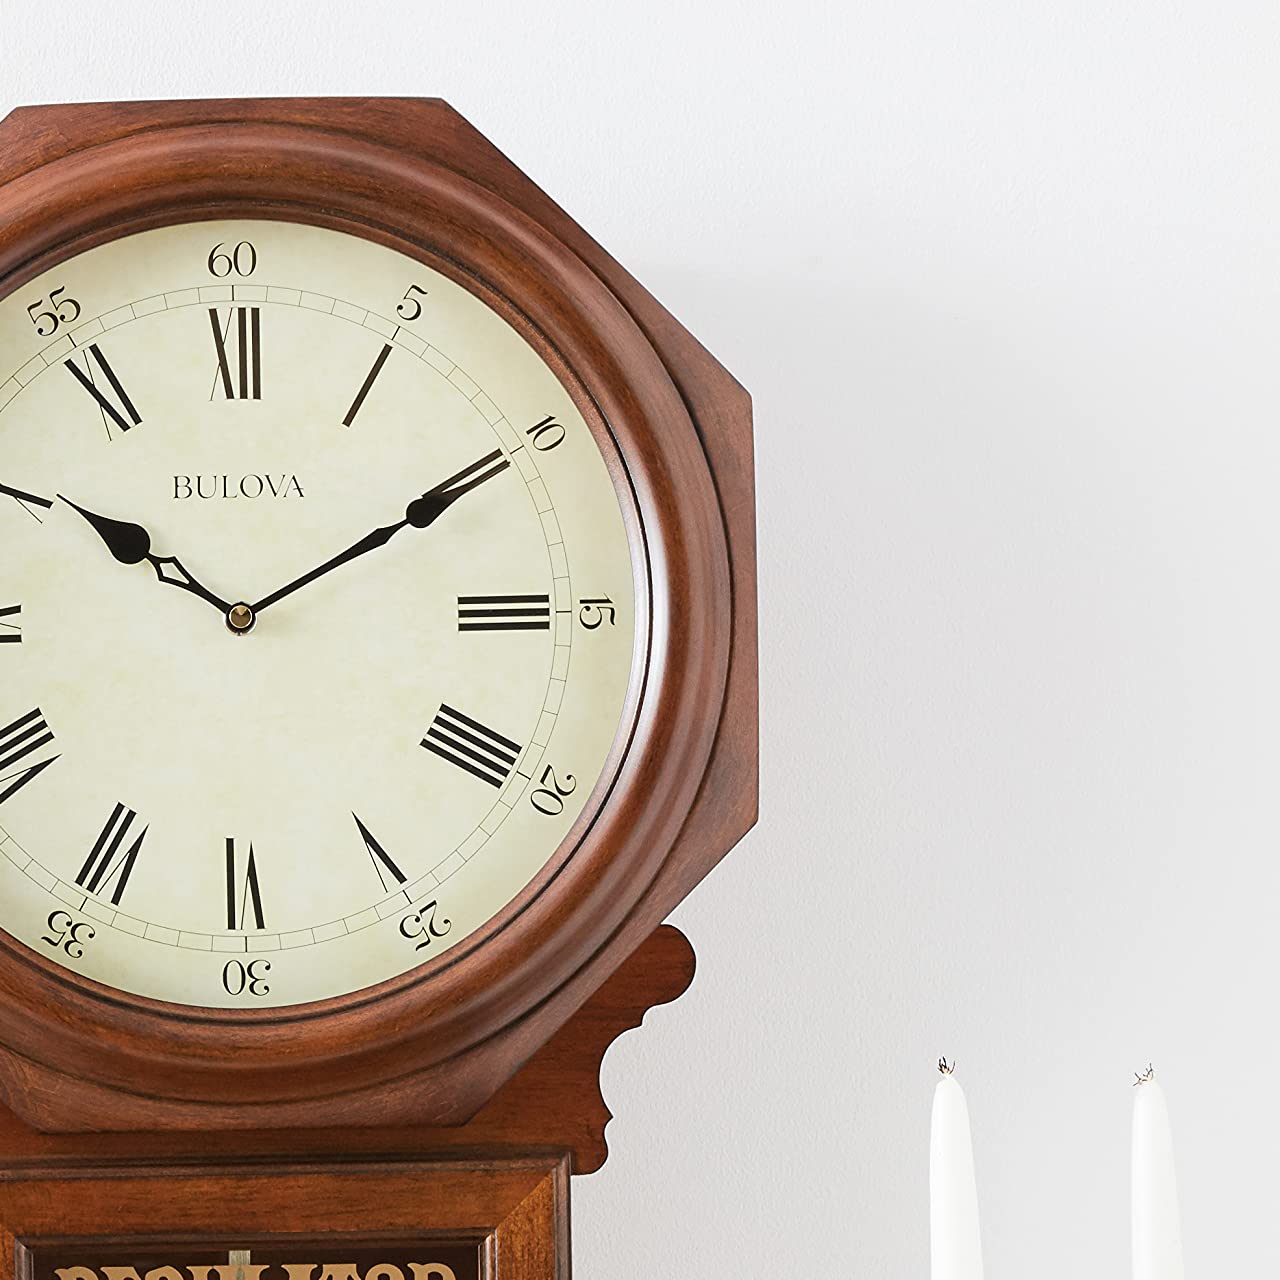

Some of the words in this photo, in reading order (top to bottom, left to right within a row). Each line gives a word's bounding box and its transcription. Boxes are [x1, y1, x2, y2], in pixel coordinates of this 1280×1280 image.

[208, 241, 257, 277] 60
[25, 286, 82, 335] 55
[396, 285, 429, 322] 5
[208, 306, 262, 401] XII
[65, 343, 142, 441] XI
[525, 413, 568, 452] 10
[173, 474, 305, 500] BULOVA
[457, 594, 550, 632] III
[579, 593, 617, 631] 15
[530, 765, 577, 817] 20
[75, 801, 150, 905] VII
[352, 811, 407, 892] V
[226, 837, 265, 931] VI
[40, 910, 96, 959] 35
[398, 899, 452, 951] 25
[222, 959, 270, 996] 30
